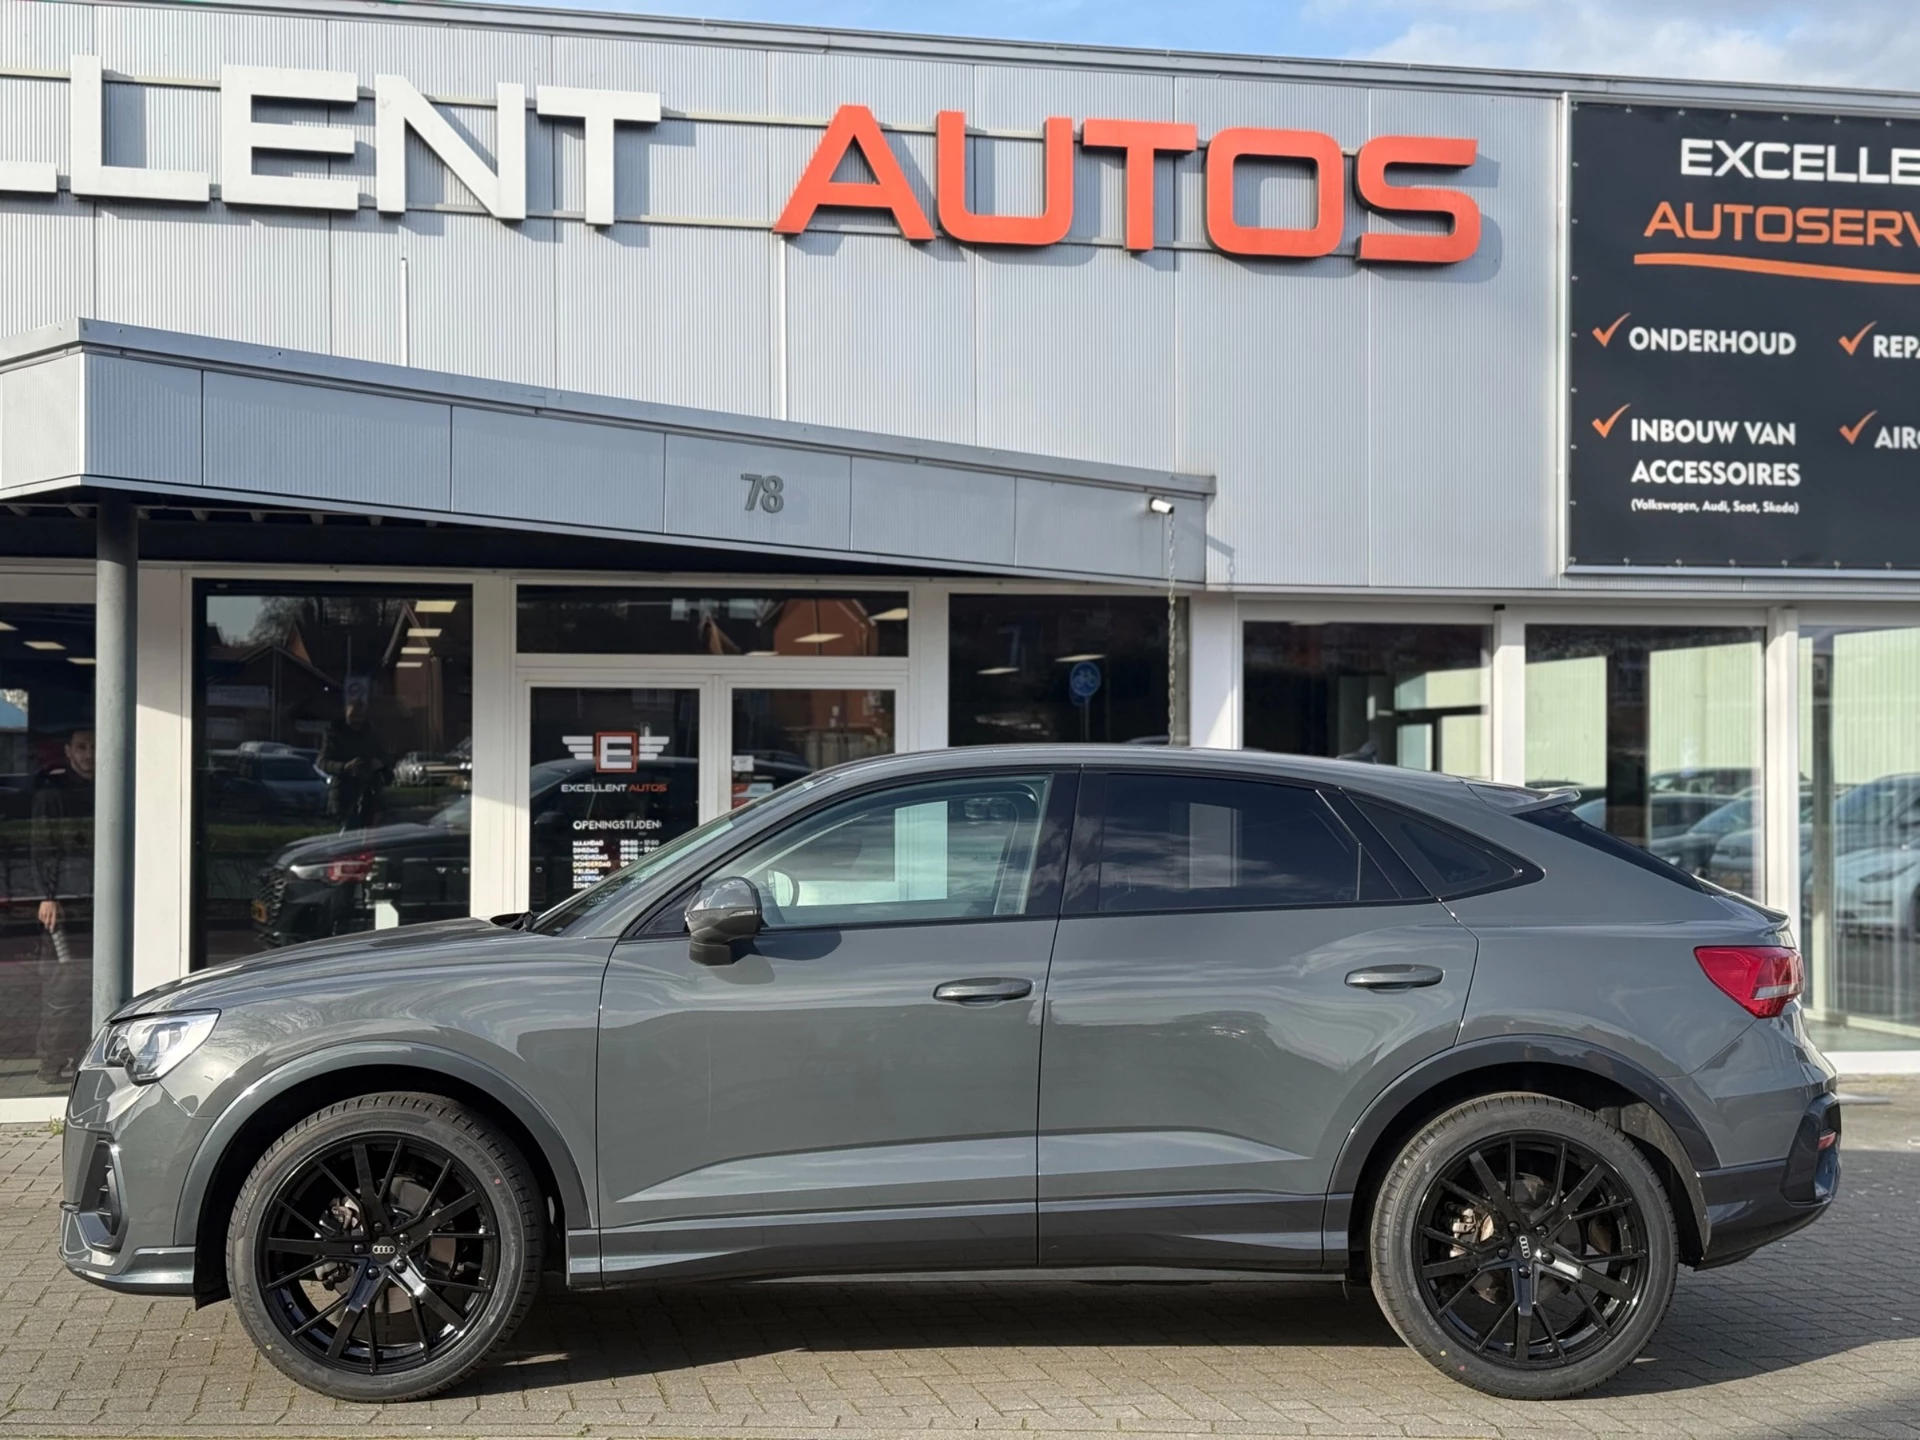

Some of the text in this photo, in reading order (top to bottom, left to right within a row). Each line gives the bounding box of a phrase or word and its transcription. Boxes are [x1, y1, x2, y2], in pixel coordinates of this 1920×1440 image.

[0, 55, 1482, 264] LENT AUTOS
[1681, 138, 1920, 186] EXCELLE
[1628, 326, 1797, 355] ONDERHOUD
[1873, 334, 1920, 359] REP
[1631, 418, 1796, 446] INBOUW VAN
[1874, 425, 1920, 449] AIR
[1631, 459, 1801, 487] ACCESSOIRES
[740, 473, 784, 513] 78
[1631, 498, 1800, 515] (Volkswagen, Audi, Seat, Skoda)
[600, 736, 632, 769] E
[561, 783, 668, 792] EXCELLENT AUTOS
